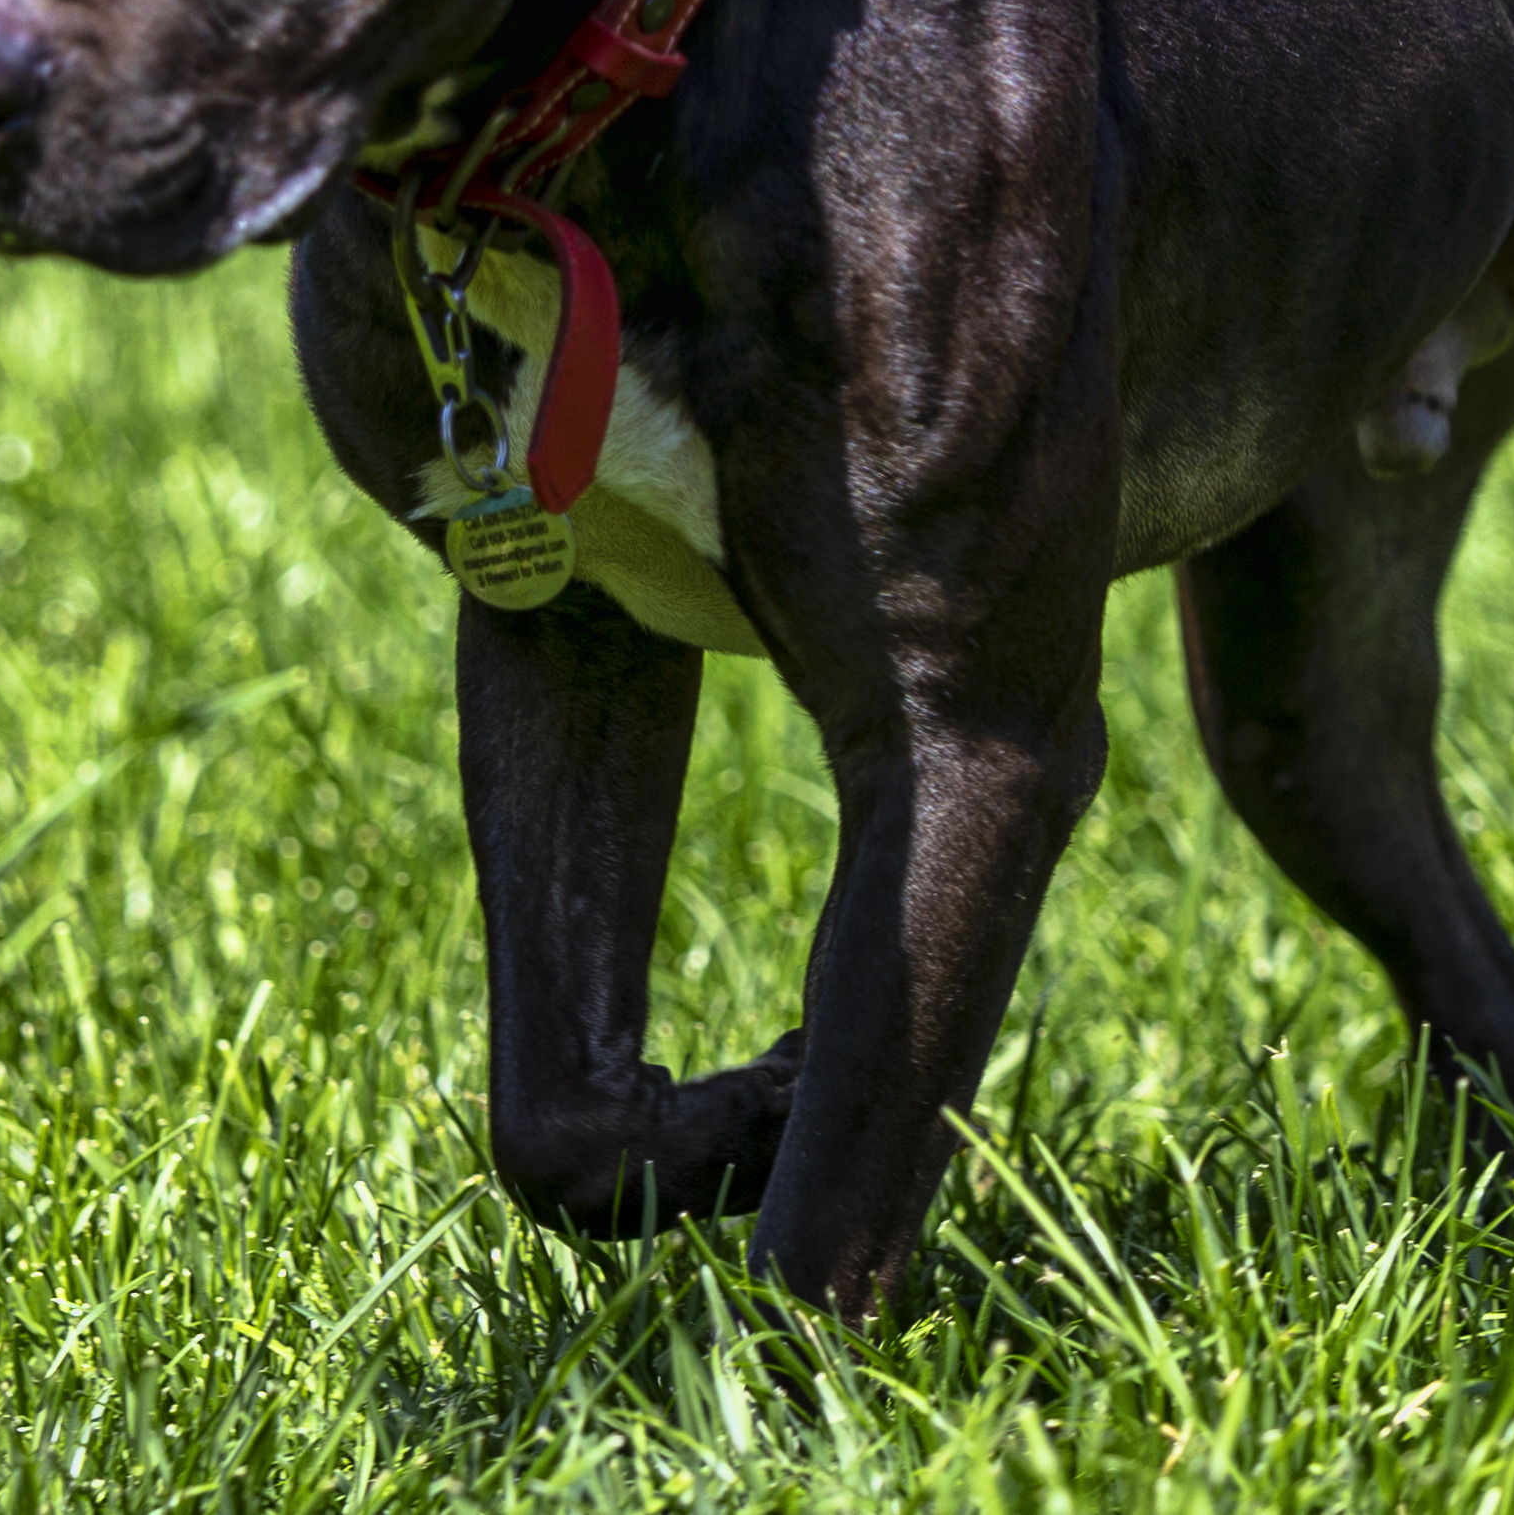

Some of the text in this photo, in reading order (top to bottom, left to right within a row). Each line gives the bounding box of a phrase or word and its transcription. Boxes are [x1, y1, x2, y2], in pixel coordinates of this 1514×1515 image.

[470, 534, 488, 550] Call
[485, 566, 520, 586] Reward
[520, 565, 533, 578] for
[534, 560, 565, 575] Return
